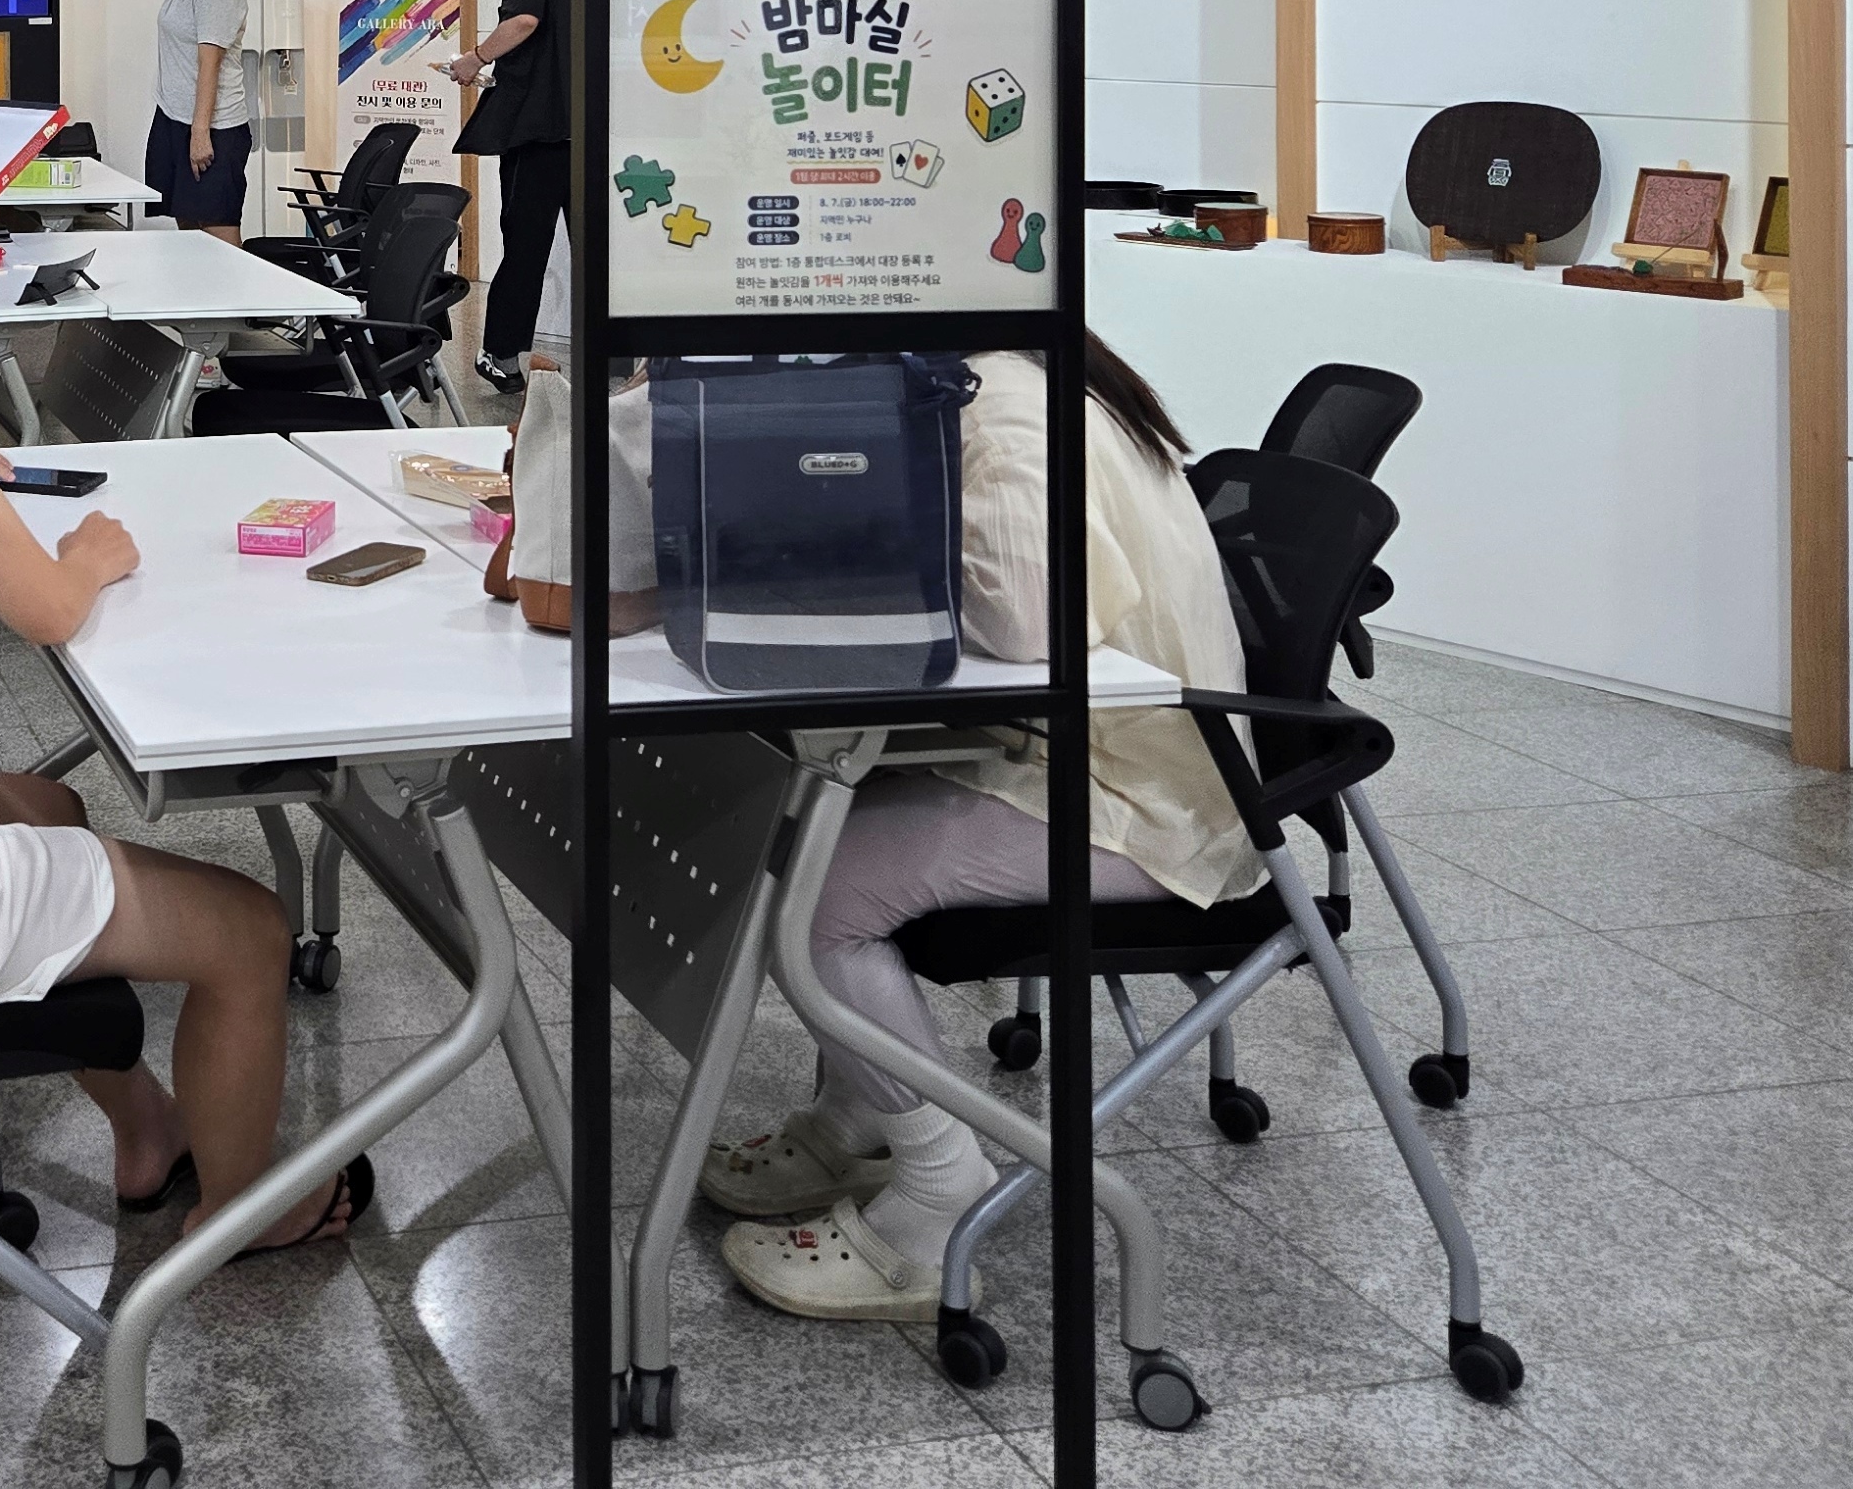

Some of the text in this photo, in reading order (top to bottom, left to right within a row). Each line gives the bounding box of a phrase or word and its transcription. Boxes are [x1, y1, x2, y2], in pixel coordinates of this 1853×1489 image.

[357, 17, 446, 31] GALLERY ARA
[761, 52, 913, 126] 놀이터
[356, 95, 443, 110] 전시 및 이용 문의
[796, 130, 875, 144] 퍼즐, 보드게임 등
[786, 147, 885, 160] 재미있는 놀잇감 대여!
[837, 171, 859, 183] 2시간
[859, 171, 876, 183] 이용
[756, 198, 773, 208] 운영
[774, 198, 791, 208] 일시
[756, 215, 773, 226] 운영
[774, 215, 791, 226] 대상
[846, 214, 873, 225] 누구나
[756, 233, 773, 244] 운영
[774, 233, 791, 244] 장소
[835, 232, 852, 242] 로비
[735, 254, 935, 269] 참여 방법: 1층 통합데스크에서 대장 등록 후
[735, 273, 942, 289] 원하는 놀잇감을 1개씩 가져와 이용해주세요
[735, 295, 756, 308] 여러
[758, 295, 780, 307] 개를
[782, 294, 815, 307] 동시에
[816, 293, 858, 306] 가져오는
[859, 293, 881, 306] 것은
